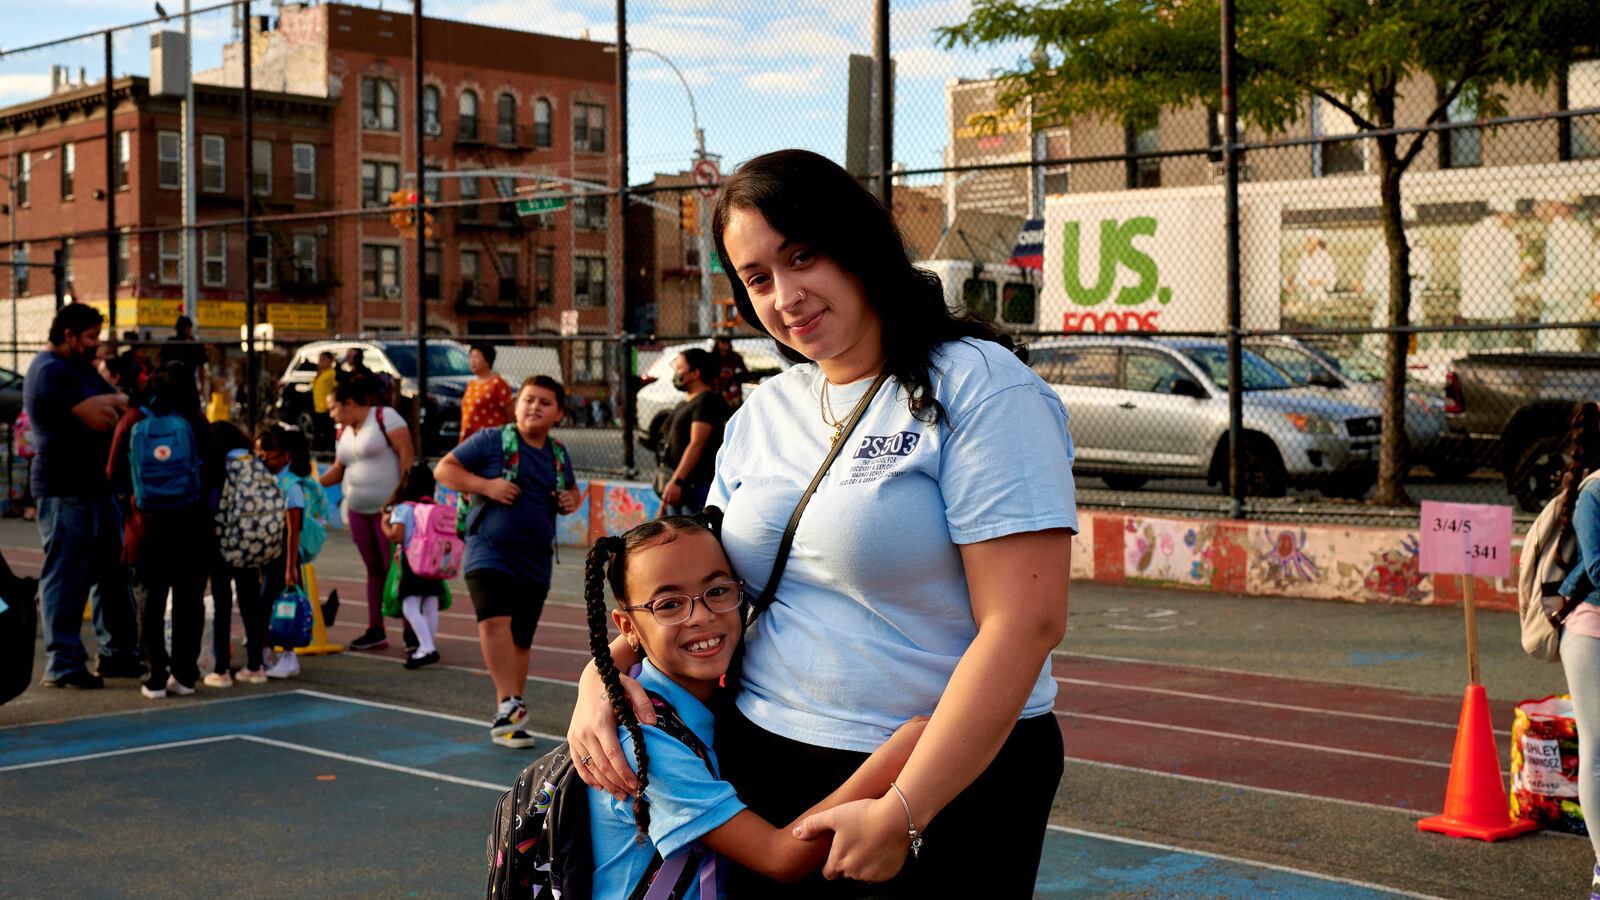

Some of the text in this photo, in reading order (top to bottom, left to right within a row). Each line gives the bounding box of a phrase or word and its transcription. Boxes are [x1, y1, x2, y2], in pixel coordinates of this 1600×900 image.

[1063, 216, 1171, 306] US.
[1063, 311, 1160, 334] FOODS
[855, 432, 917, 457] PS503
[1433, 517, 1471, 533] 3/4/5
[1465, 544, 1496, 559] -341
